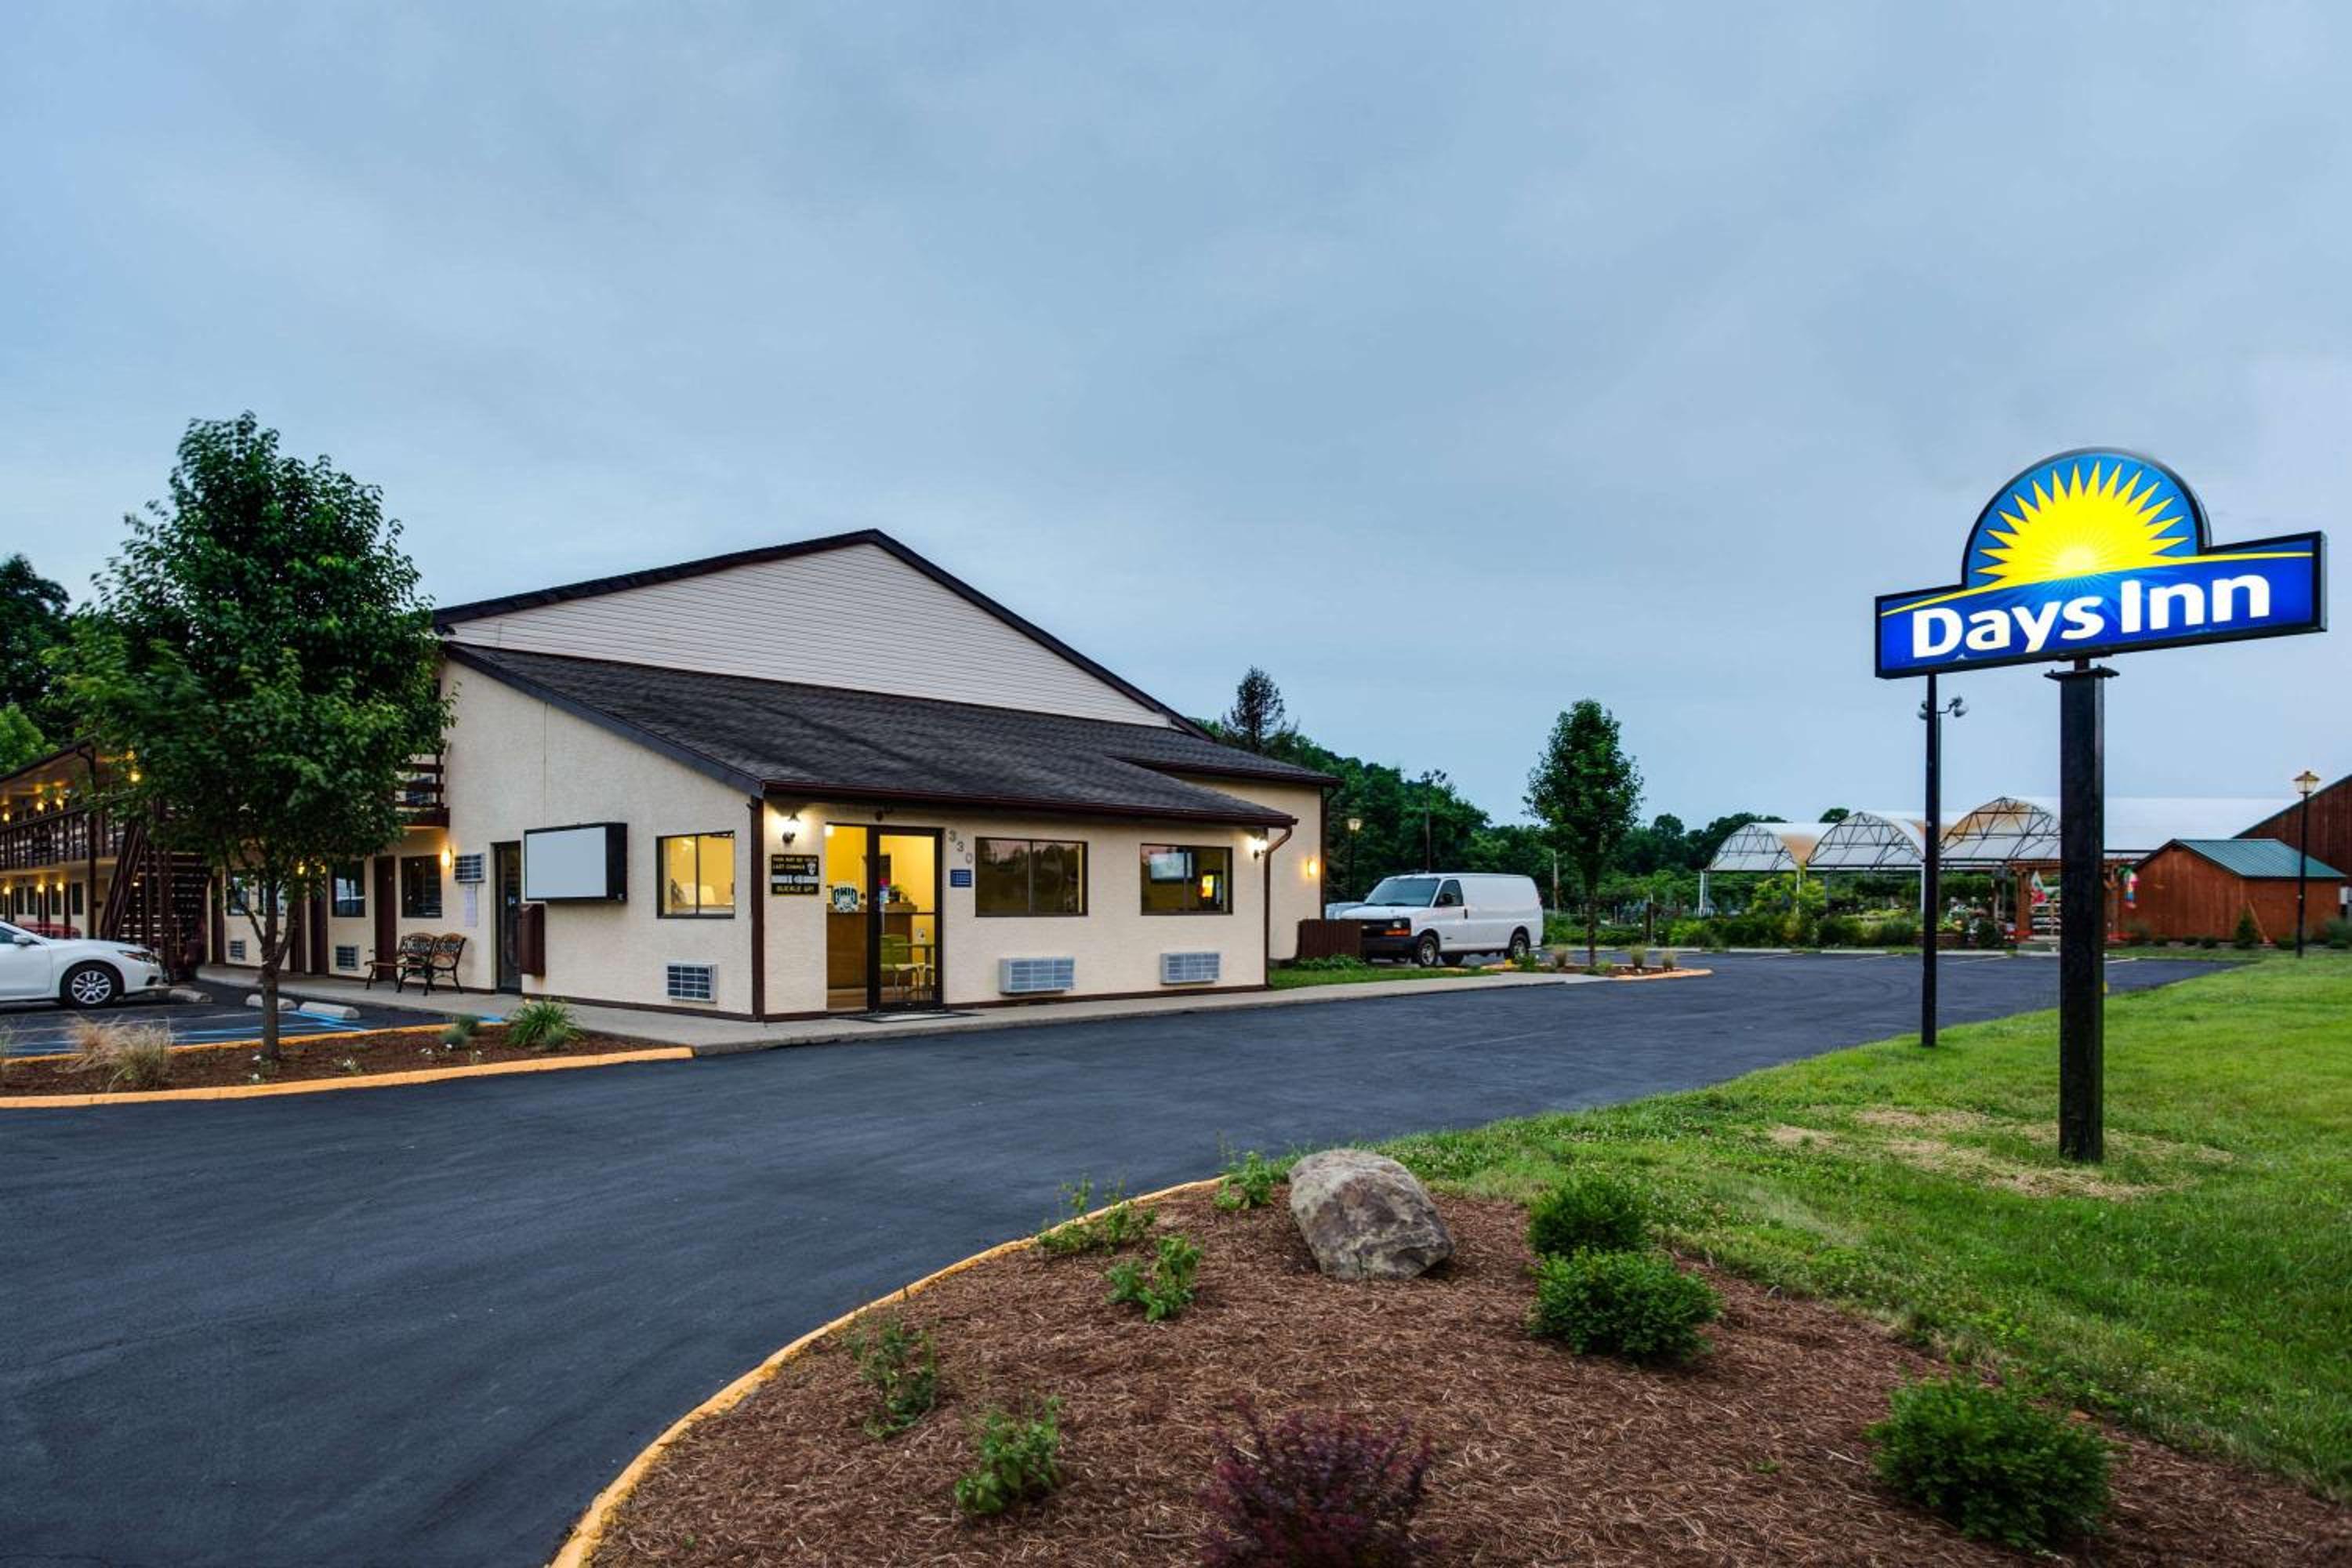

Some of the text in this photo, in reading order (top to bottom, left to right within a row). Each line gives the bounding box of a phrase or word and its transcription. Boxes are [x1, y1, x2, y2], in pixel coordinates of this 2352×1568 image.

[1912, 574, 2270, 659] Days Inn
[949, 829, 973, 864] 330
[833, 887, 857, 906] OHIO
